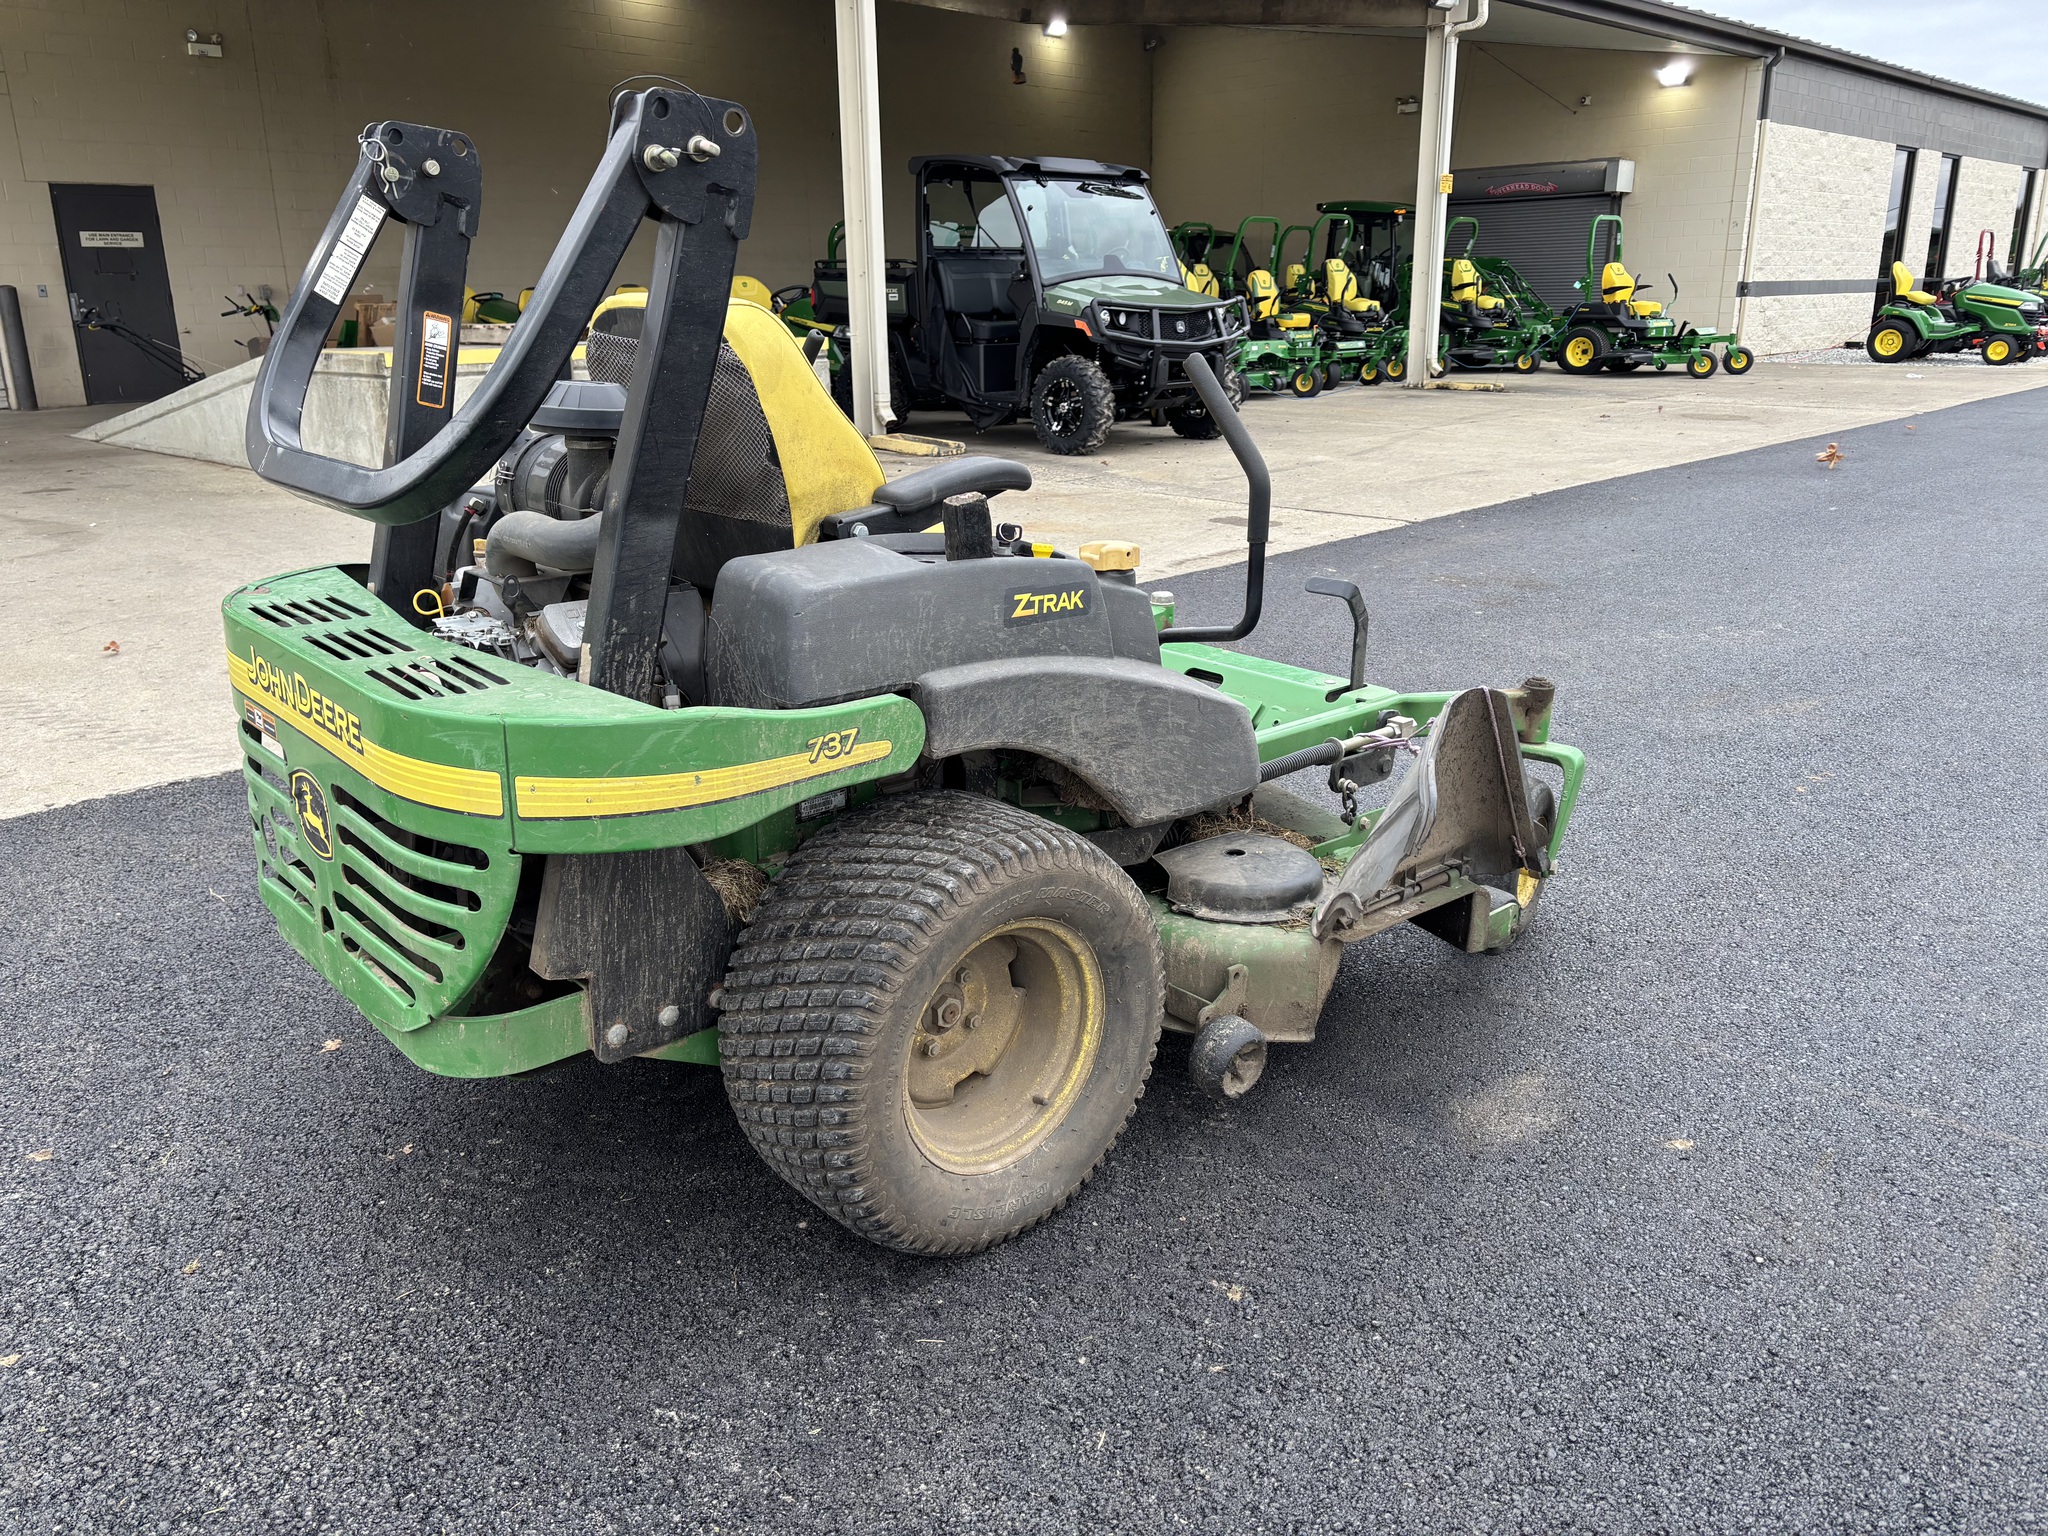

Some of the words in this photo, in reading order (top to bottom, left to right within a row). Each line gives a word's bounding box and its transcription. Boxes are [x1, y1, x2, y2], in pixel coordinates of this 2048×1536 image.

[246, 644, 298, 713] JOHN
[293, 670, 365, 757] DEERE
[806, 727, 860, 764] 737
[1036, 886, 1111, 915] MASTER
[946, 1182, 1050, 1221] CARLISLE
